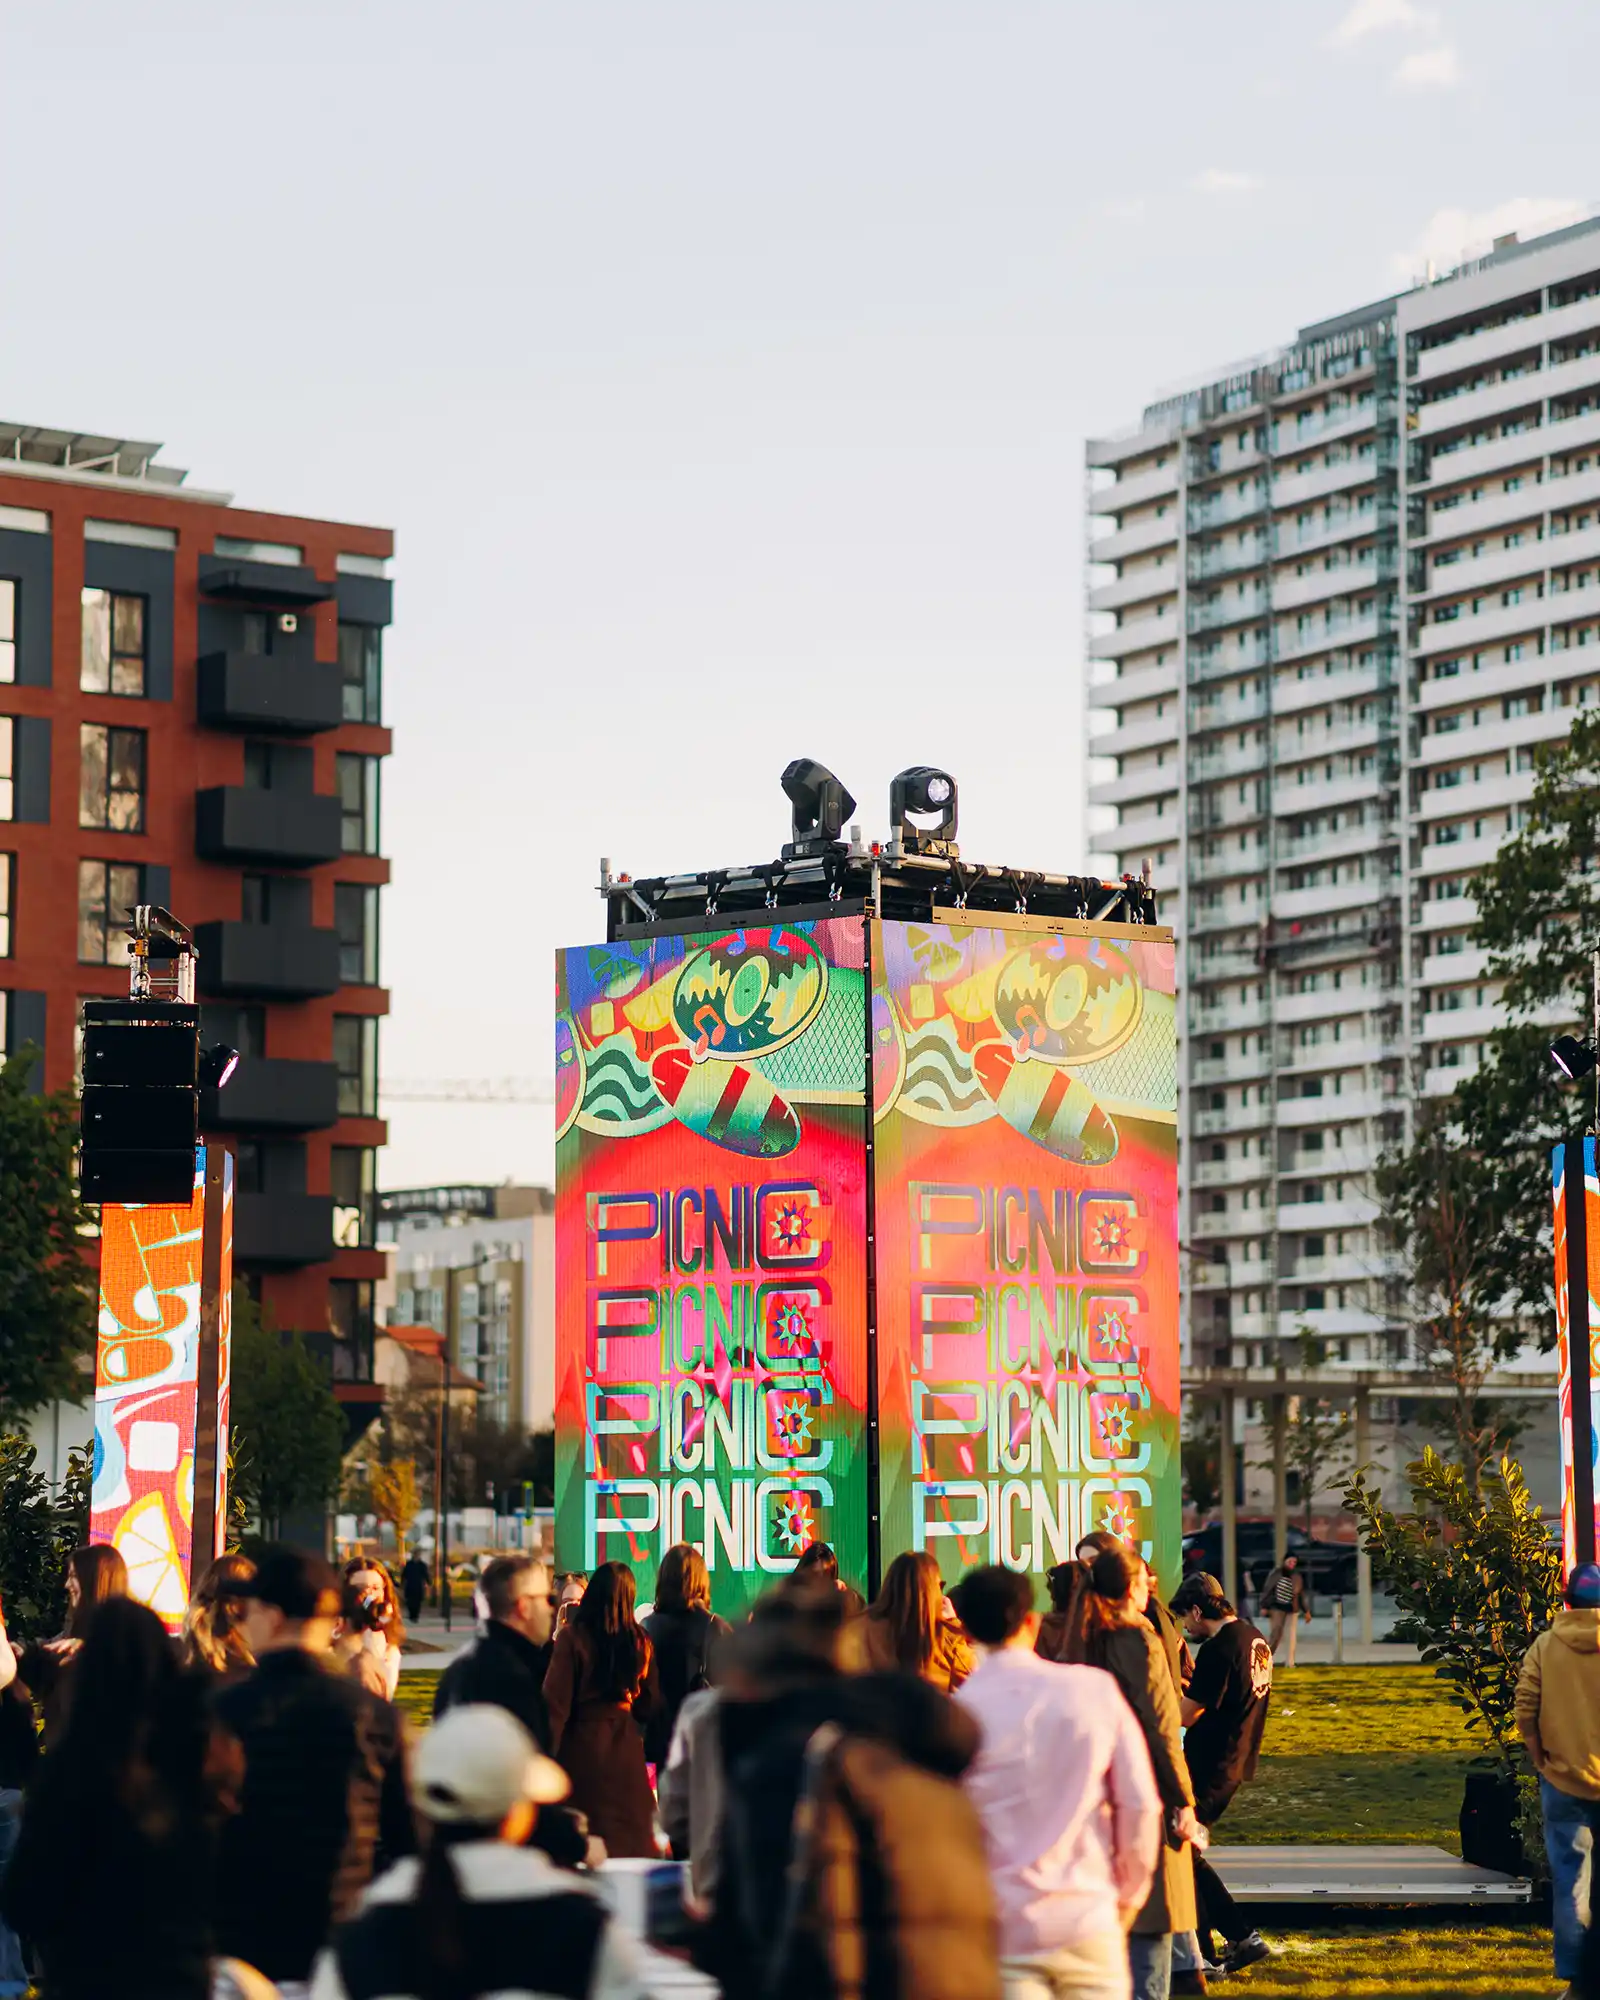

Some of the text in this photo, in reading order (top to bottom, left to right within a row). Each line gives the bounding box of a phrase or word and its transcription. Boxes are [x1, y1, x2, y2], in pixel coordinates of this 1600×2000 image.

[586, 1178, 832, 1280] PICNIC
[908, 1181, 1148, 1279] PICNIC
[586, 1276, 832, 1377] PICNIC
[910, 1281, 1149, 1376] PICNIC
[585, 1375, 833, 1472] PICNIC
[911, 1379, 1151, 1475] PICNIC
[585, 1476, 833, 1573] PICNIC
[912, 1478, 1152, 1573] PICNIC
